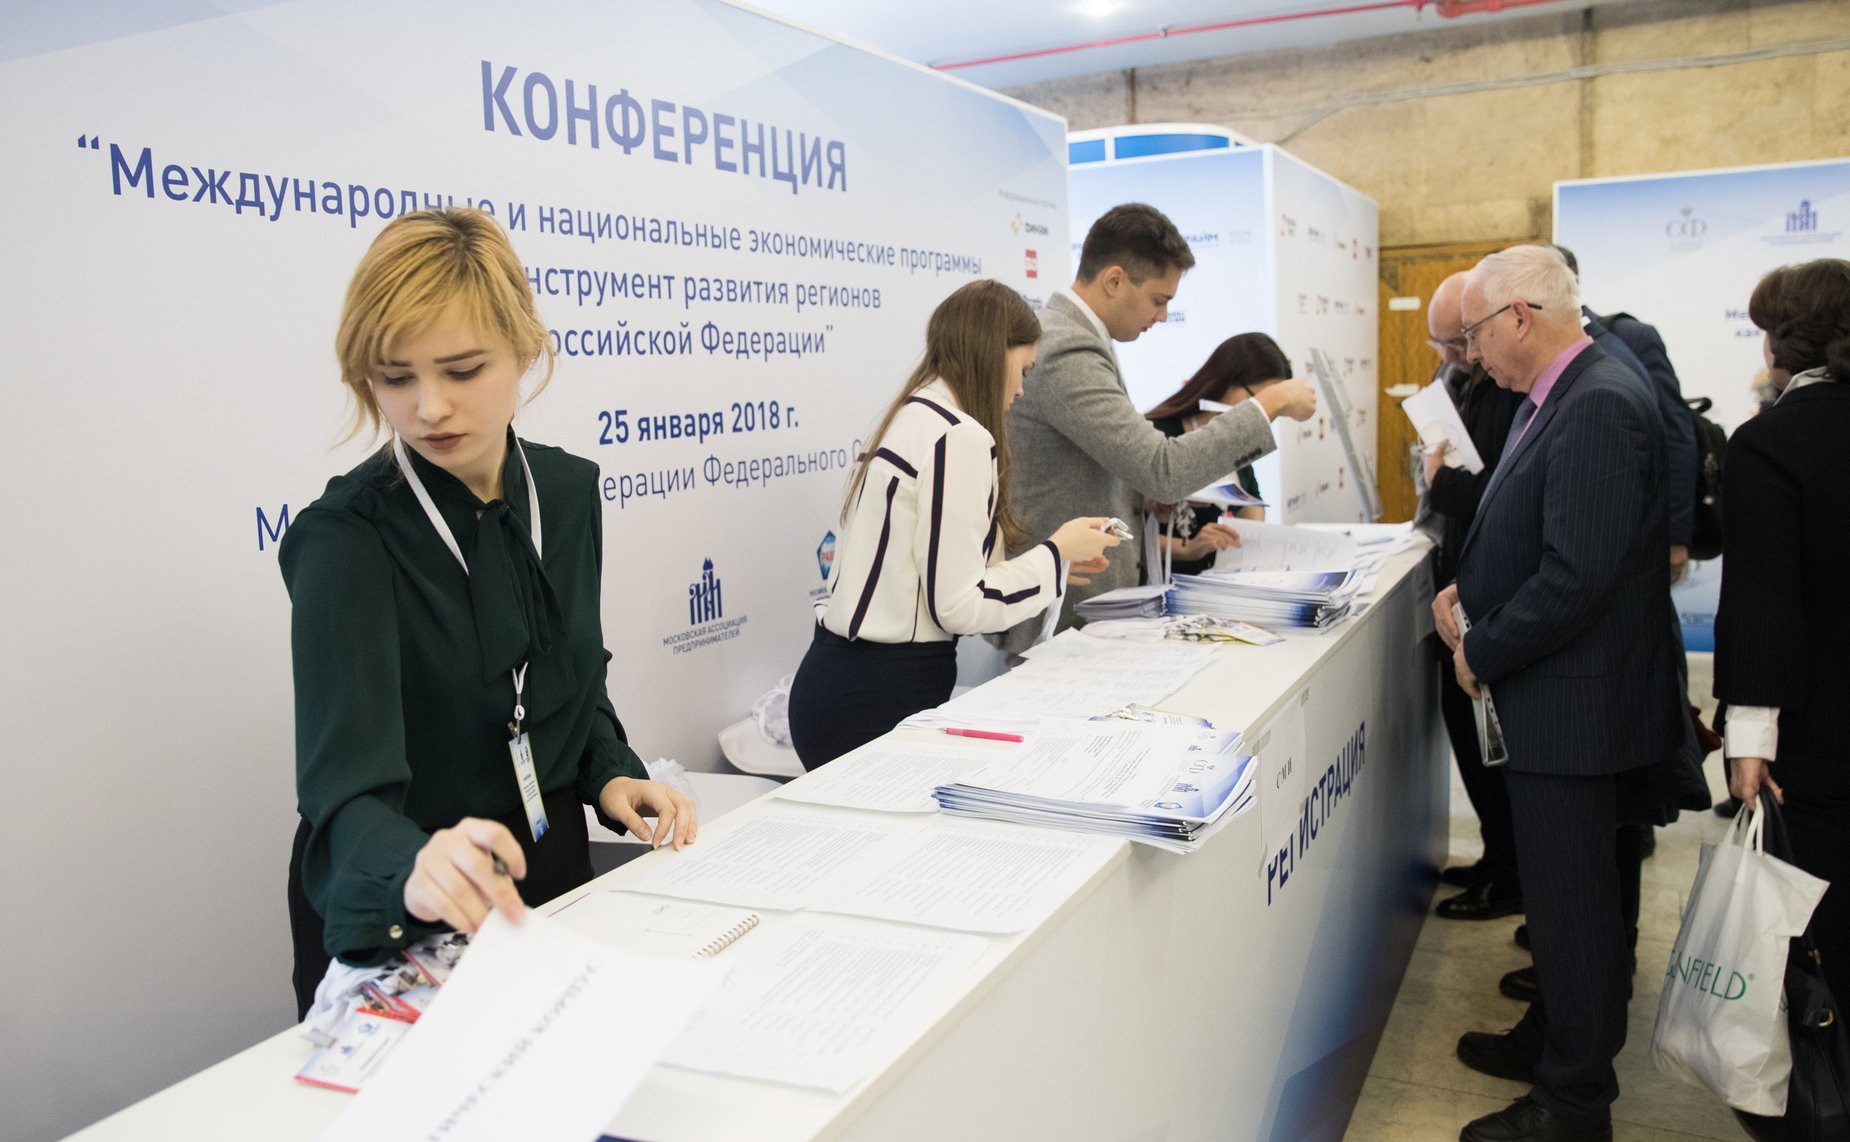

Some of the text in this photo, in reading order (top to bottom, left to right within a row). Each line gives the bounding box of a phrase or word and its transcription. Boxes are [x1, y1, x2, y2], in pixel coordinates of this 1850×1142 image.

[480, 60, 848, 195] КОНФЕРЕНЦИЯ
[508, 202, 526, 231] и
[538, 203, 741, 250] национальные
[748, 228, 896, 266] экономические
[900, 246, 982, 276] программы
[525, 267, 882, 313] нструмент развития регионов
[548, 320, 693, 357] оссийской
[597, 401, 799, 445] 25 января 2018 г.
[603, 466, 696, 509] ерации
[703, 448, 847, 489] Федерального
[662, 615, 748, 647] МОСКОВСКАЯ АССОЦИАЦИЯ
[673, 628, 741, 656] ПРЕДПРИНИМАТЕЛЕЙ
